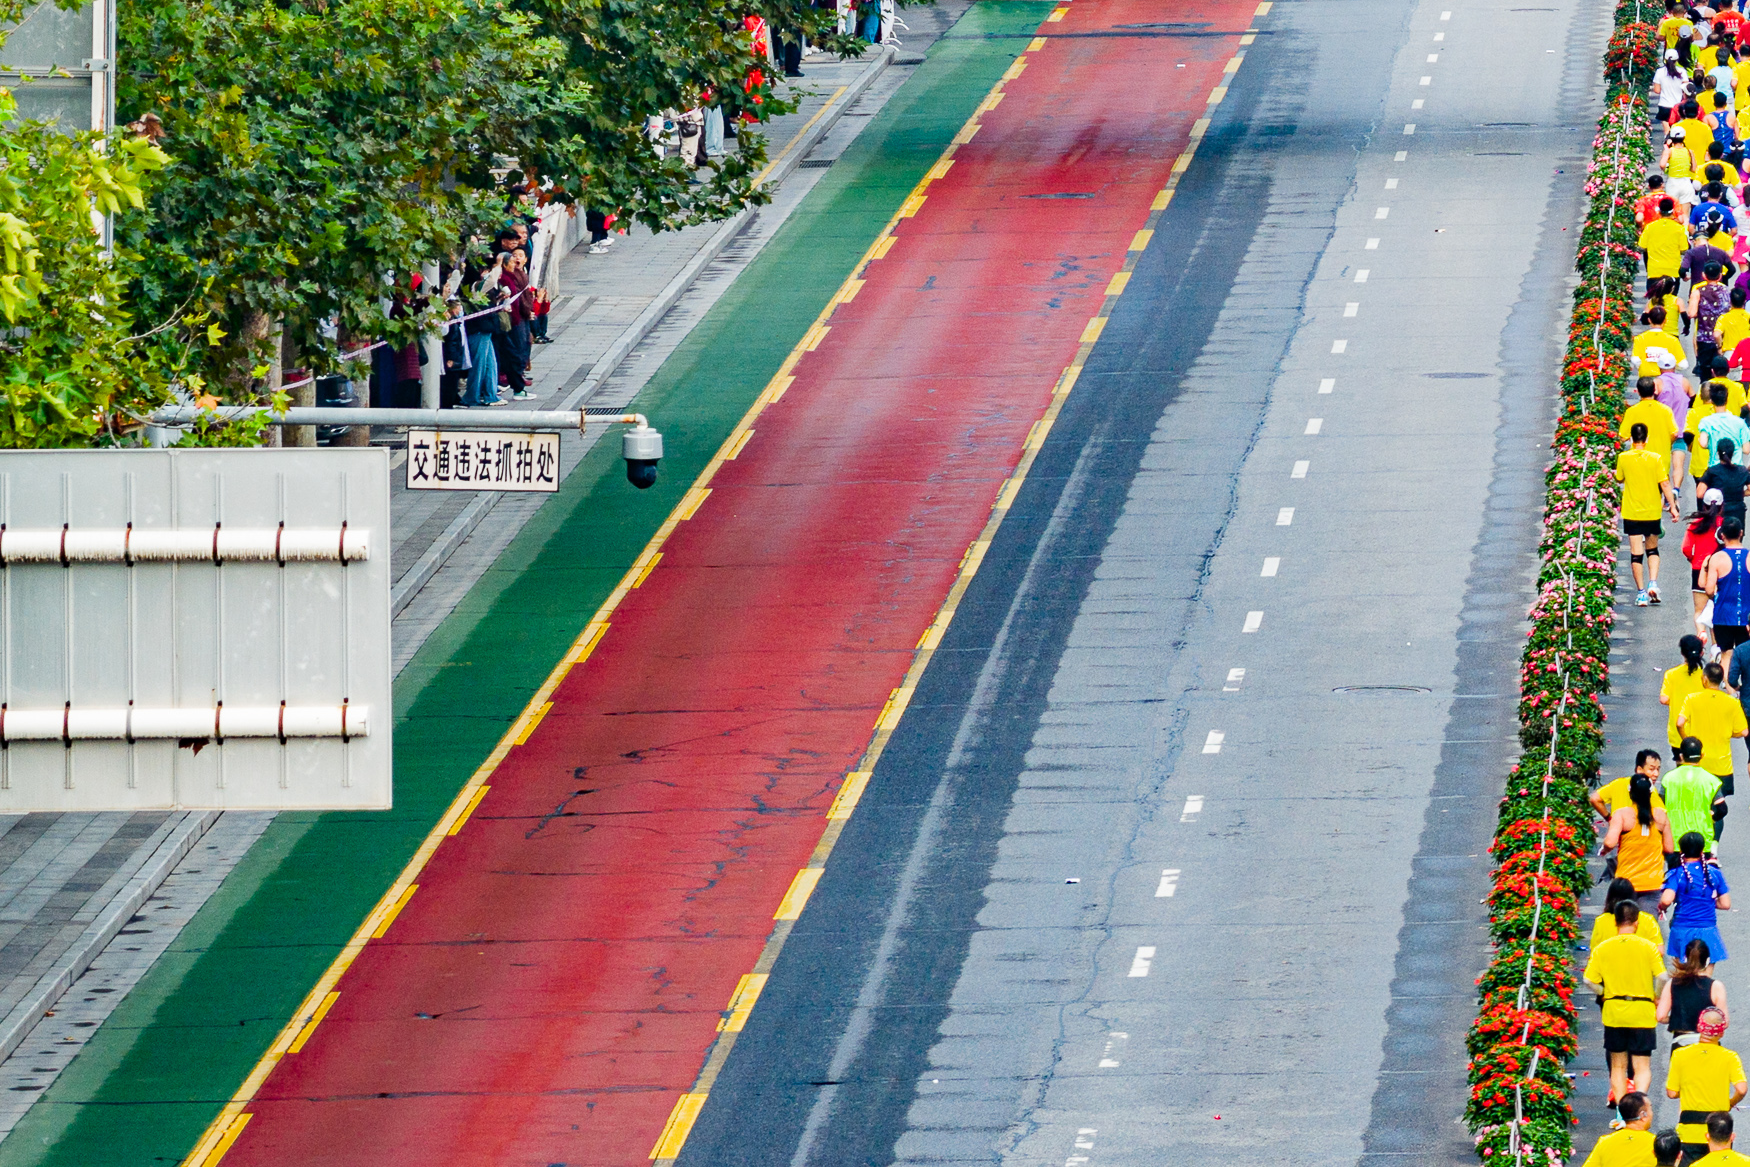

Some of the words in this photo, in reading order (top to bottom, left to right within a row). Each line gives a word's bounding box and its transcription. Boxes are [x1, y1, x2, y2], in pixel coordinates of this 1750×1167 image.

[412, 439, 555, 484] 交通违法抓拍处
